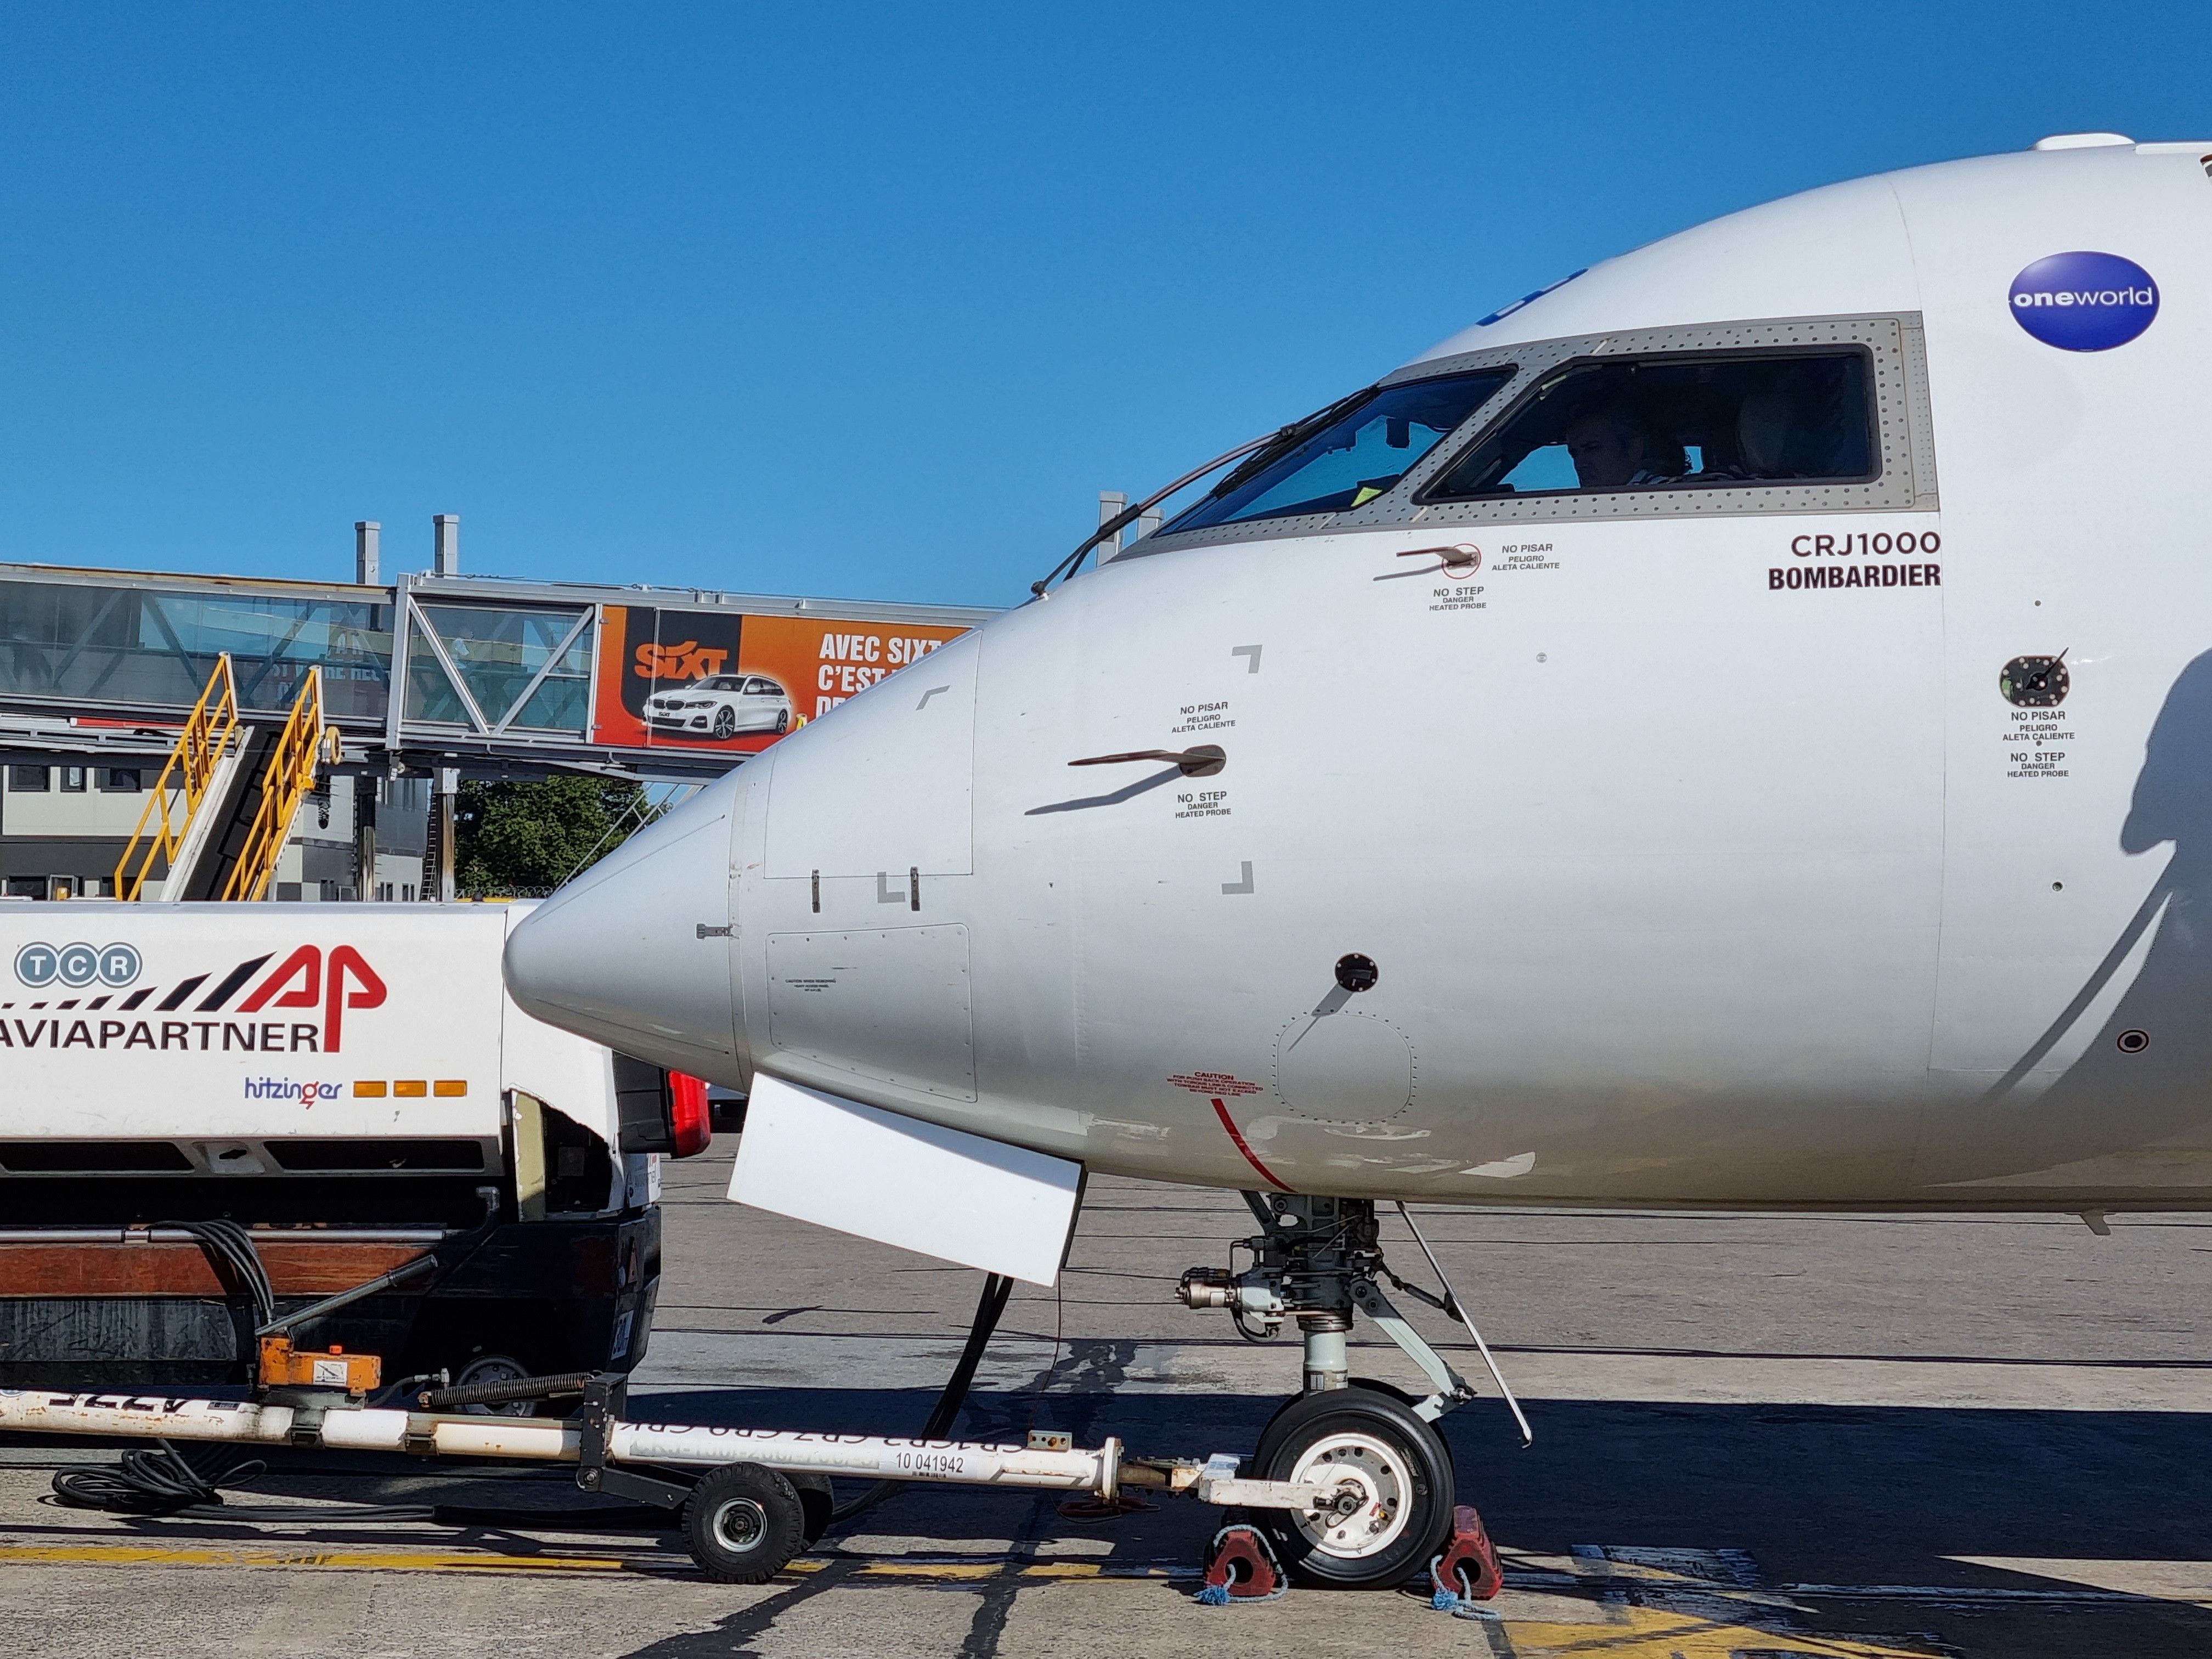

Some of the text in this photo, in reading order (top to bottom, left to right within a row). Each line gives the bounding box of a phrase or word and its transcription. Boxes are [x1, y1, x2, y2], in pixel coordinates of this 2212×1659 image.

[2014, 286, 2153, 307] oneworld
[1501, 543, 1553, 554] NO PISAR
[1791, 531, 1941, 557] CRJ1000
[1768, 563, 1942, 590] BOMBARDIER
[1433, 586, 1485, 597] NO STEP
[819, 634, 880, 662] AVEC
[1180, 702, 1229, 714] NO PISAR
[1187, 714, 1221, 724] PELIGRO
[2011, 711, 2066, 721] NO PISAR
[1171, 720, 1236, 733] ALETA CALIENTE
[2011, 753, 2066, 762] NO STEP
[1177, 791, 1227, 803] NO STEP
[1205, 808, 1232, 816] PROBE
[1194, 1071, 1234, 1080] CAUTION
[245, 1076, 343, 1109] hitzinger
[896, 1452, 911, 1469] 10
[916, 1454, 964, 1473] 041942
